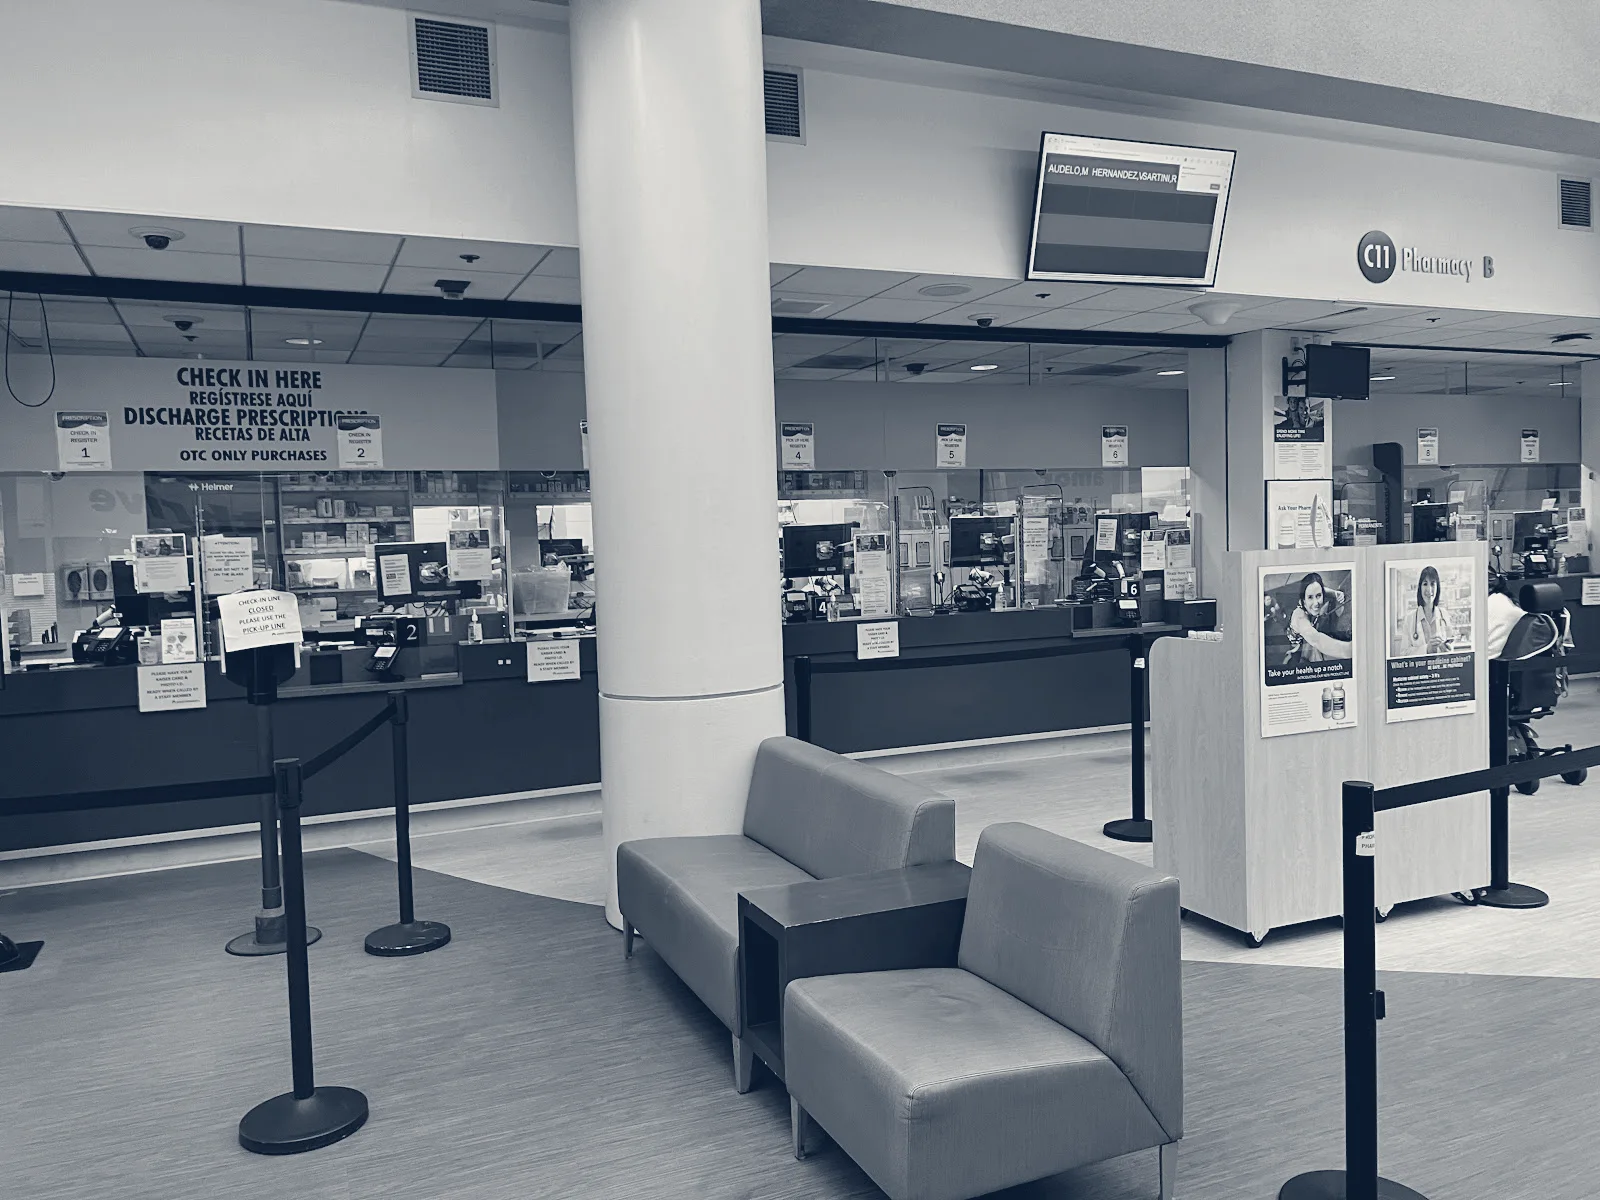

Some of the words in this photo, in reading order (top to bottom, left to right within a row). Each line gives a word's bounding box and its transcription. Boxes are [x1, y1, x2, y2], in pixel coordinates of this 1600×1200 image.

[1048, 163, 1089, 176] AUDELO,M
[1364, 244, 1390, 269] C11
[1402, 247, 1472, 283] Pharmacy
[1483, 255, 1495, 279] B
[177, 367, 241, 388] CHECK
[248, 369, 269, 388] IN
[276, 370, 322, 389] HERE
[189, 388, 273, 407] REGÍSTRESE
[277, 390, 313, 408] AQUÍ
[124, 407, 231, 426] DISCHARGE
[236, 410, 368, 428] PRESCRIPTI
[195, 427, 253, 442] RECETAS
[257, 428, 275, 442] DE
[279, 428, 311, 442] ALTA
[81, 447, 91, 458] 1
[180, 450, 208, 461] OTC
[211, 450, 247, 462] ONLY
[251, 450, 328, 462] PURCHASES
[357, 447, 365, 458] 2
[795, 451, 802, 460] 4
[949, 450, 955, 459] 5
[1112, 450, 1119, 459] 6
[201, 483, 234, 492] Helmer
[1130, 584, 1138, 595] 6
[239, 597, 267, 606] CHECK-IN
[985, 592, 993, 606] 5
[248, 605, 274, 614] CLOSED
[818, 601, 827, 614] 4
[239, 616, 260, 625] PLEASE
[242, 624, 270, 633] PICK-UP
[406, 624, 418, 641] 2
[1391, 661, 1408, 669] What's
[1414, 660, 1426, 668] your
[1427, 658, 1449, 666] medicine
[1450, 655, 1471, 663] cabinet?
[1267, 669, 1281, 678] Take
[1281, 669, 1295, 678] your
[1295, 666, 1313, 674] health
[1327, 663, 1343, 672] notch
